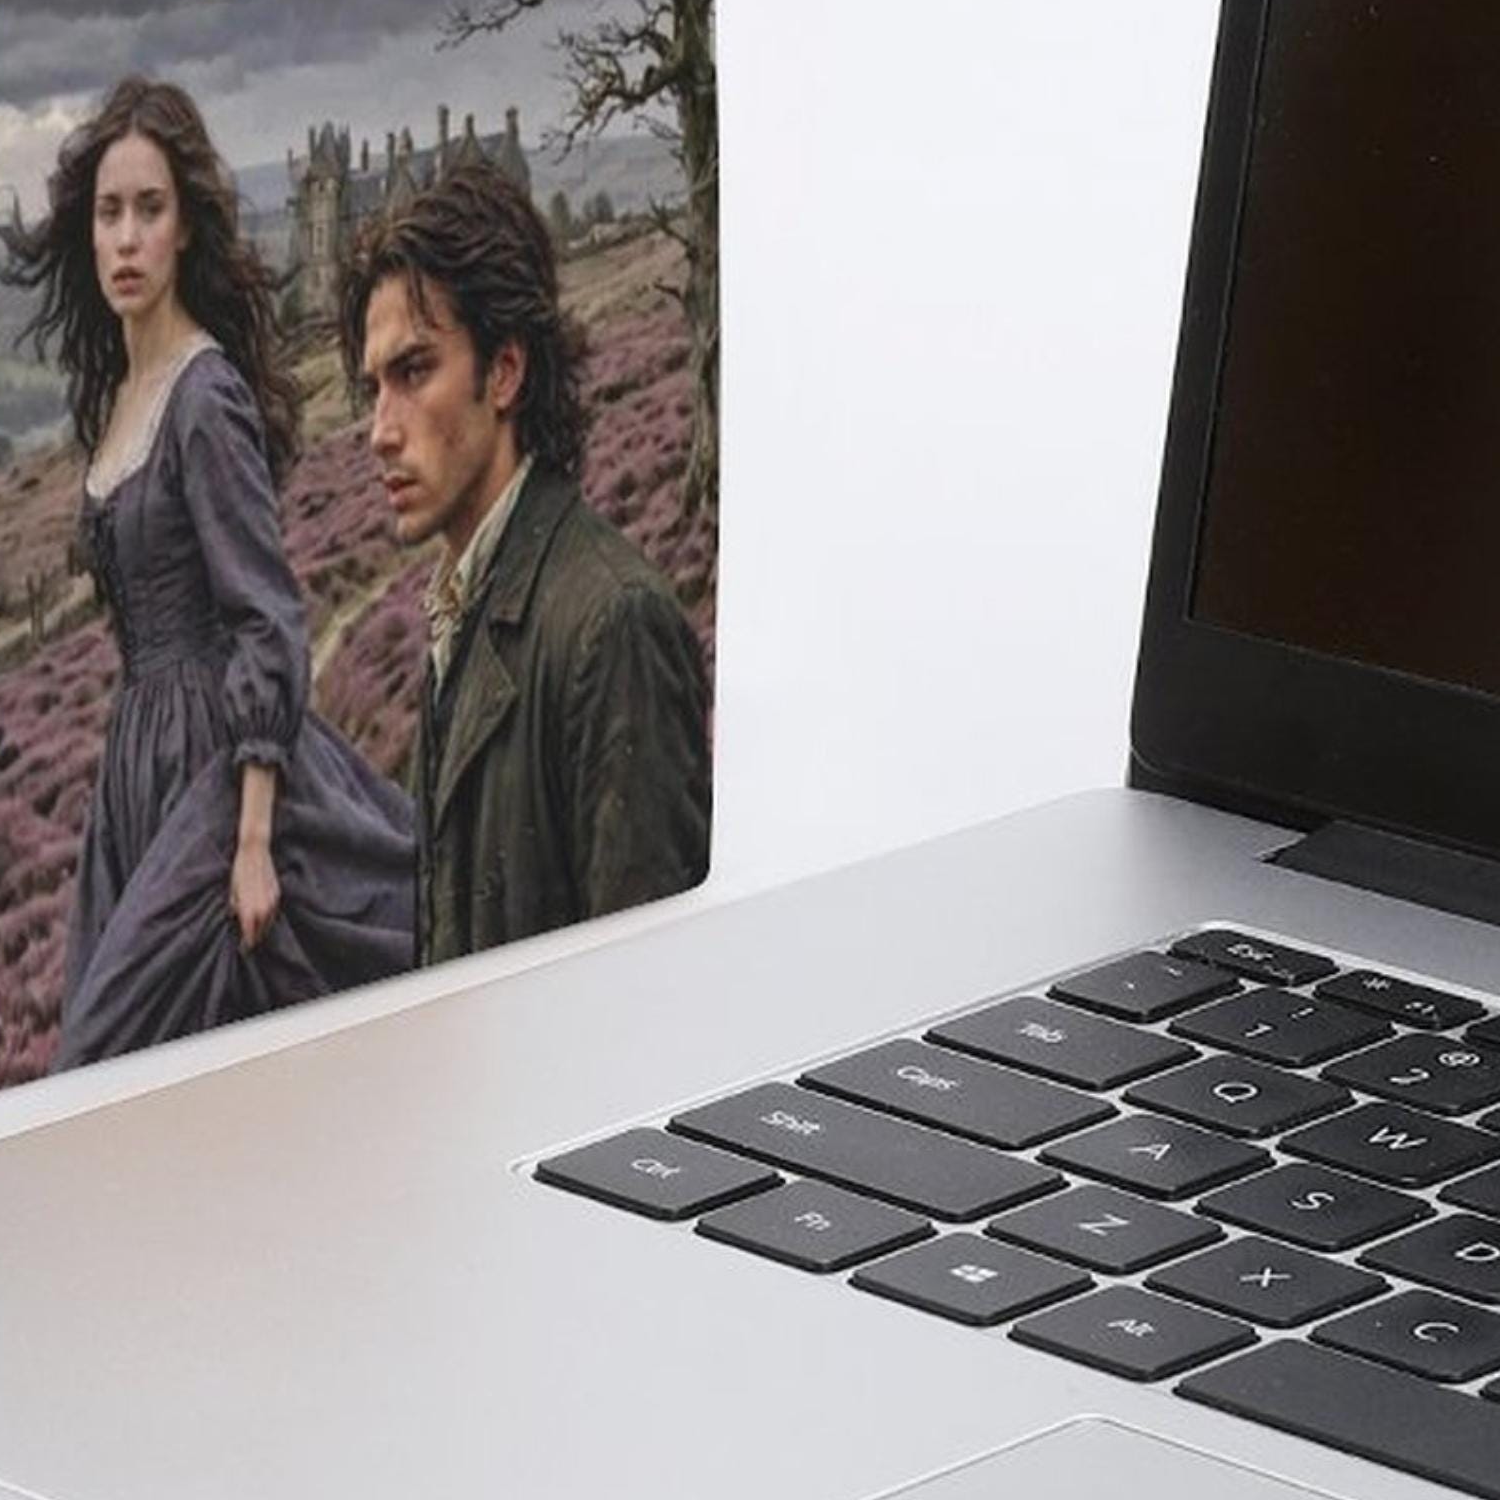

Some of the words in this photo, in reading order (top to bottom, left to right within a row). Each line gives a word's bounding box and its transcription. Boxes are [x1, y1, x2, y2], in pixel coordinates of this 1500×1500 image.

[896, 1064, 960, 1091] Caps
[1212, 1082, 1259, 1104] Q
[1368, 1126, 1428, 1150] W
[1127, 1141, 1173, 1161] A
[1291, 1191, 1335, 1210] S
[1078, 1212, 1130, 1236] Z
[1239, 1265, 1292, 1288] X
[1412, 1321, 1460, 1343] C
